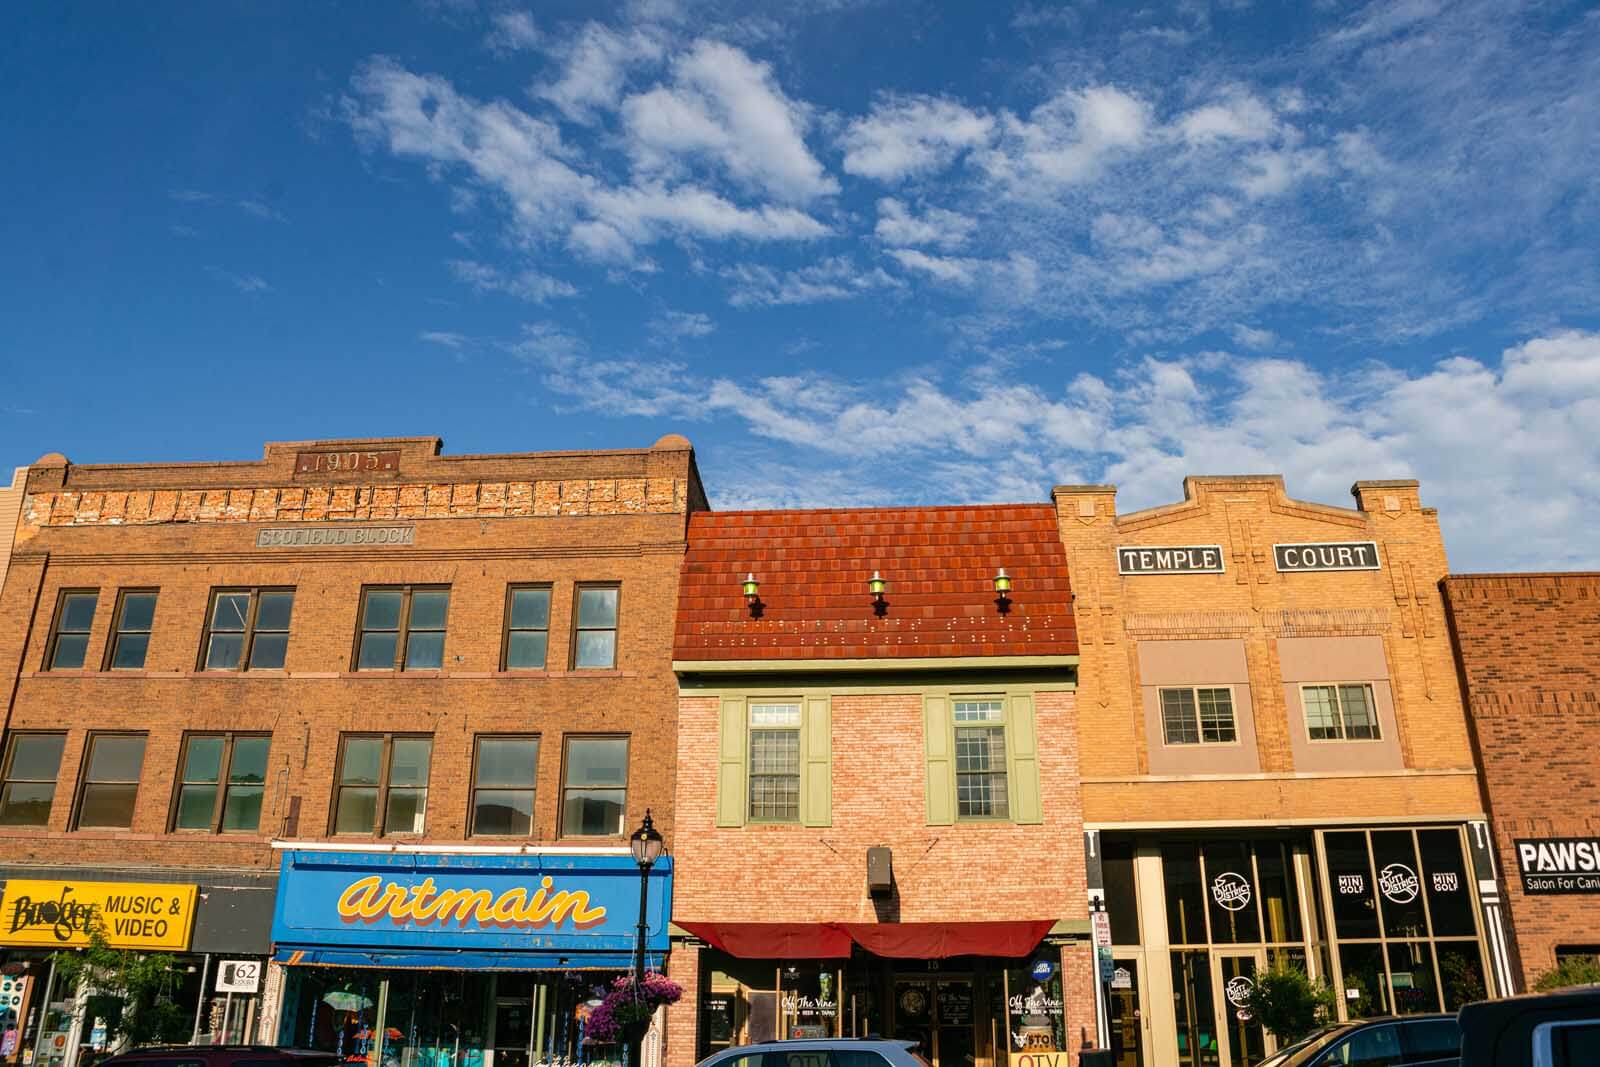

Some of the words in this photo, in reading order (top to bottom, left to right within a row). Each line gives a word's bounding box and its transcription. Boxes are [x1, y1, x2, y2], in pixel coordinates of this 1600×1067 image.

[314, 452, 379, 472] 1905
[260, 529, 347, 545] SCOFIELD
[352, 527, 414, 544] BLOCK
[1123, 550, 1218, 570] TEMPLE
[1284, 547, 1368, 566] COURT
[1338, 876, 1363, 887] MINI
[1432, 874, 1458, 885] MINI
[1527, 878, 1555, 889] Salon
[1558, 877, 1574, 889] For
[1340, 885, 1364, 894] GOLF
[1434, 883, 1459, 892] GOLF
[105, 896, 163, 914] MUSIC
[168, 897, 181, 915] &
[115, 919, 168, 937] VIDEO
[236, 964, 256, 978] 62
[781, 995, 795, 1009] Off
[797, 995, 814, 1008] The
[815, 998, 836, 1008] Vine
[1009, 994, 1023, 1010] Off
[1024, 996, 1042, 1009] The
[1042, 997, 1063, 1007] Vine
